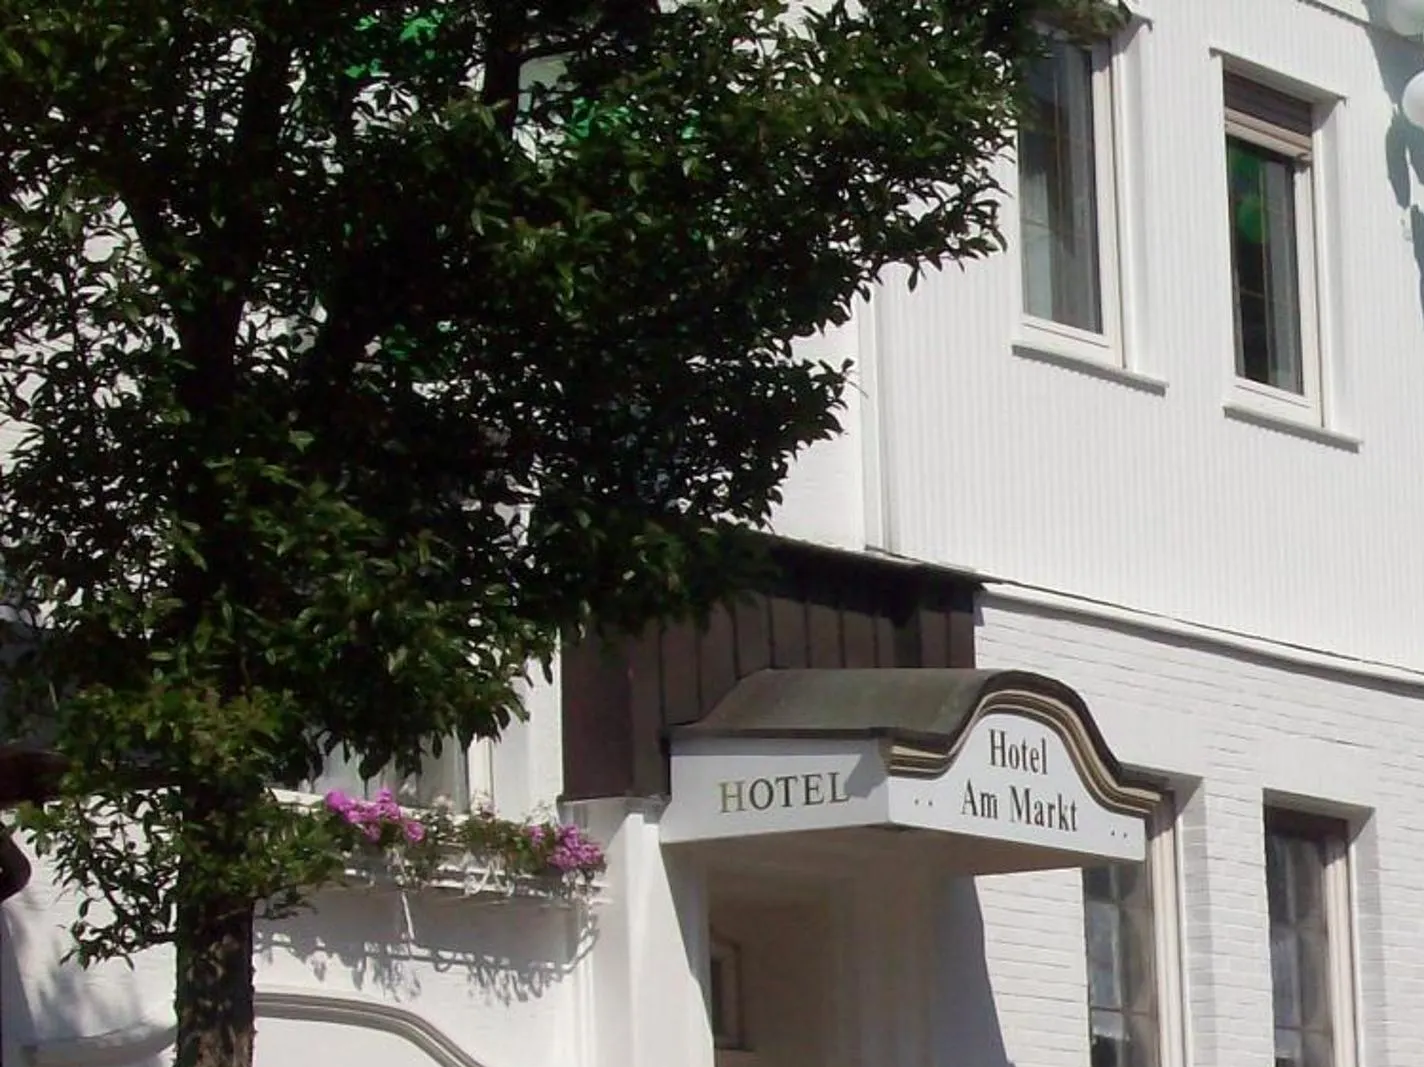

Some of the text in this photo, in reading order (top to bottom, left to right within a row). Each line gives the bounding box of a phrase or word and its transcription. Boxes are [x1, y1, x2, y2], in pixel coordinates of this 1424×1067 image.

[989, 729, 1048, 775] Hotel
[719, 772, 849, 813] HOTEL
[961, 779, 1079, 832] Am Markt
